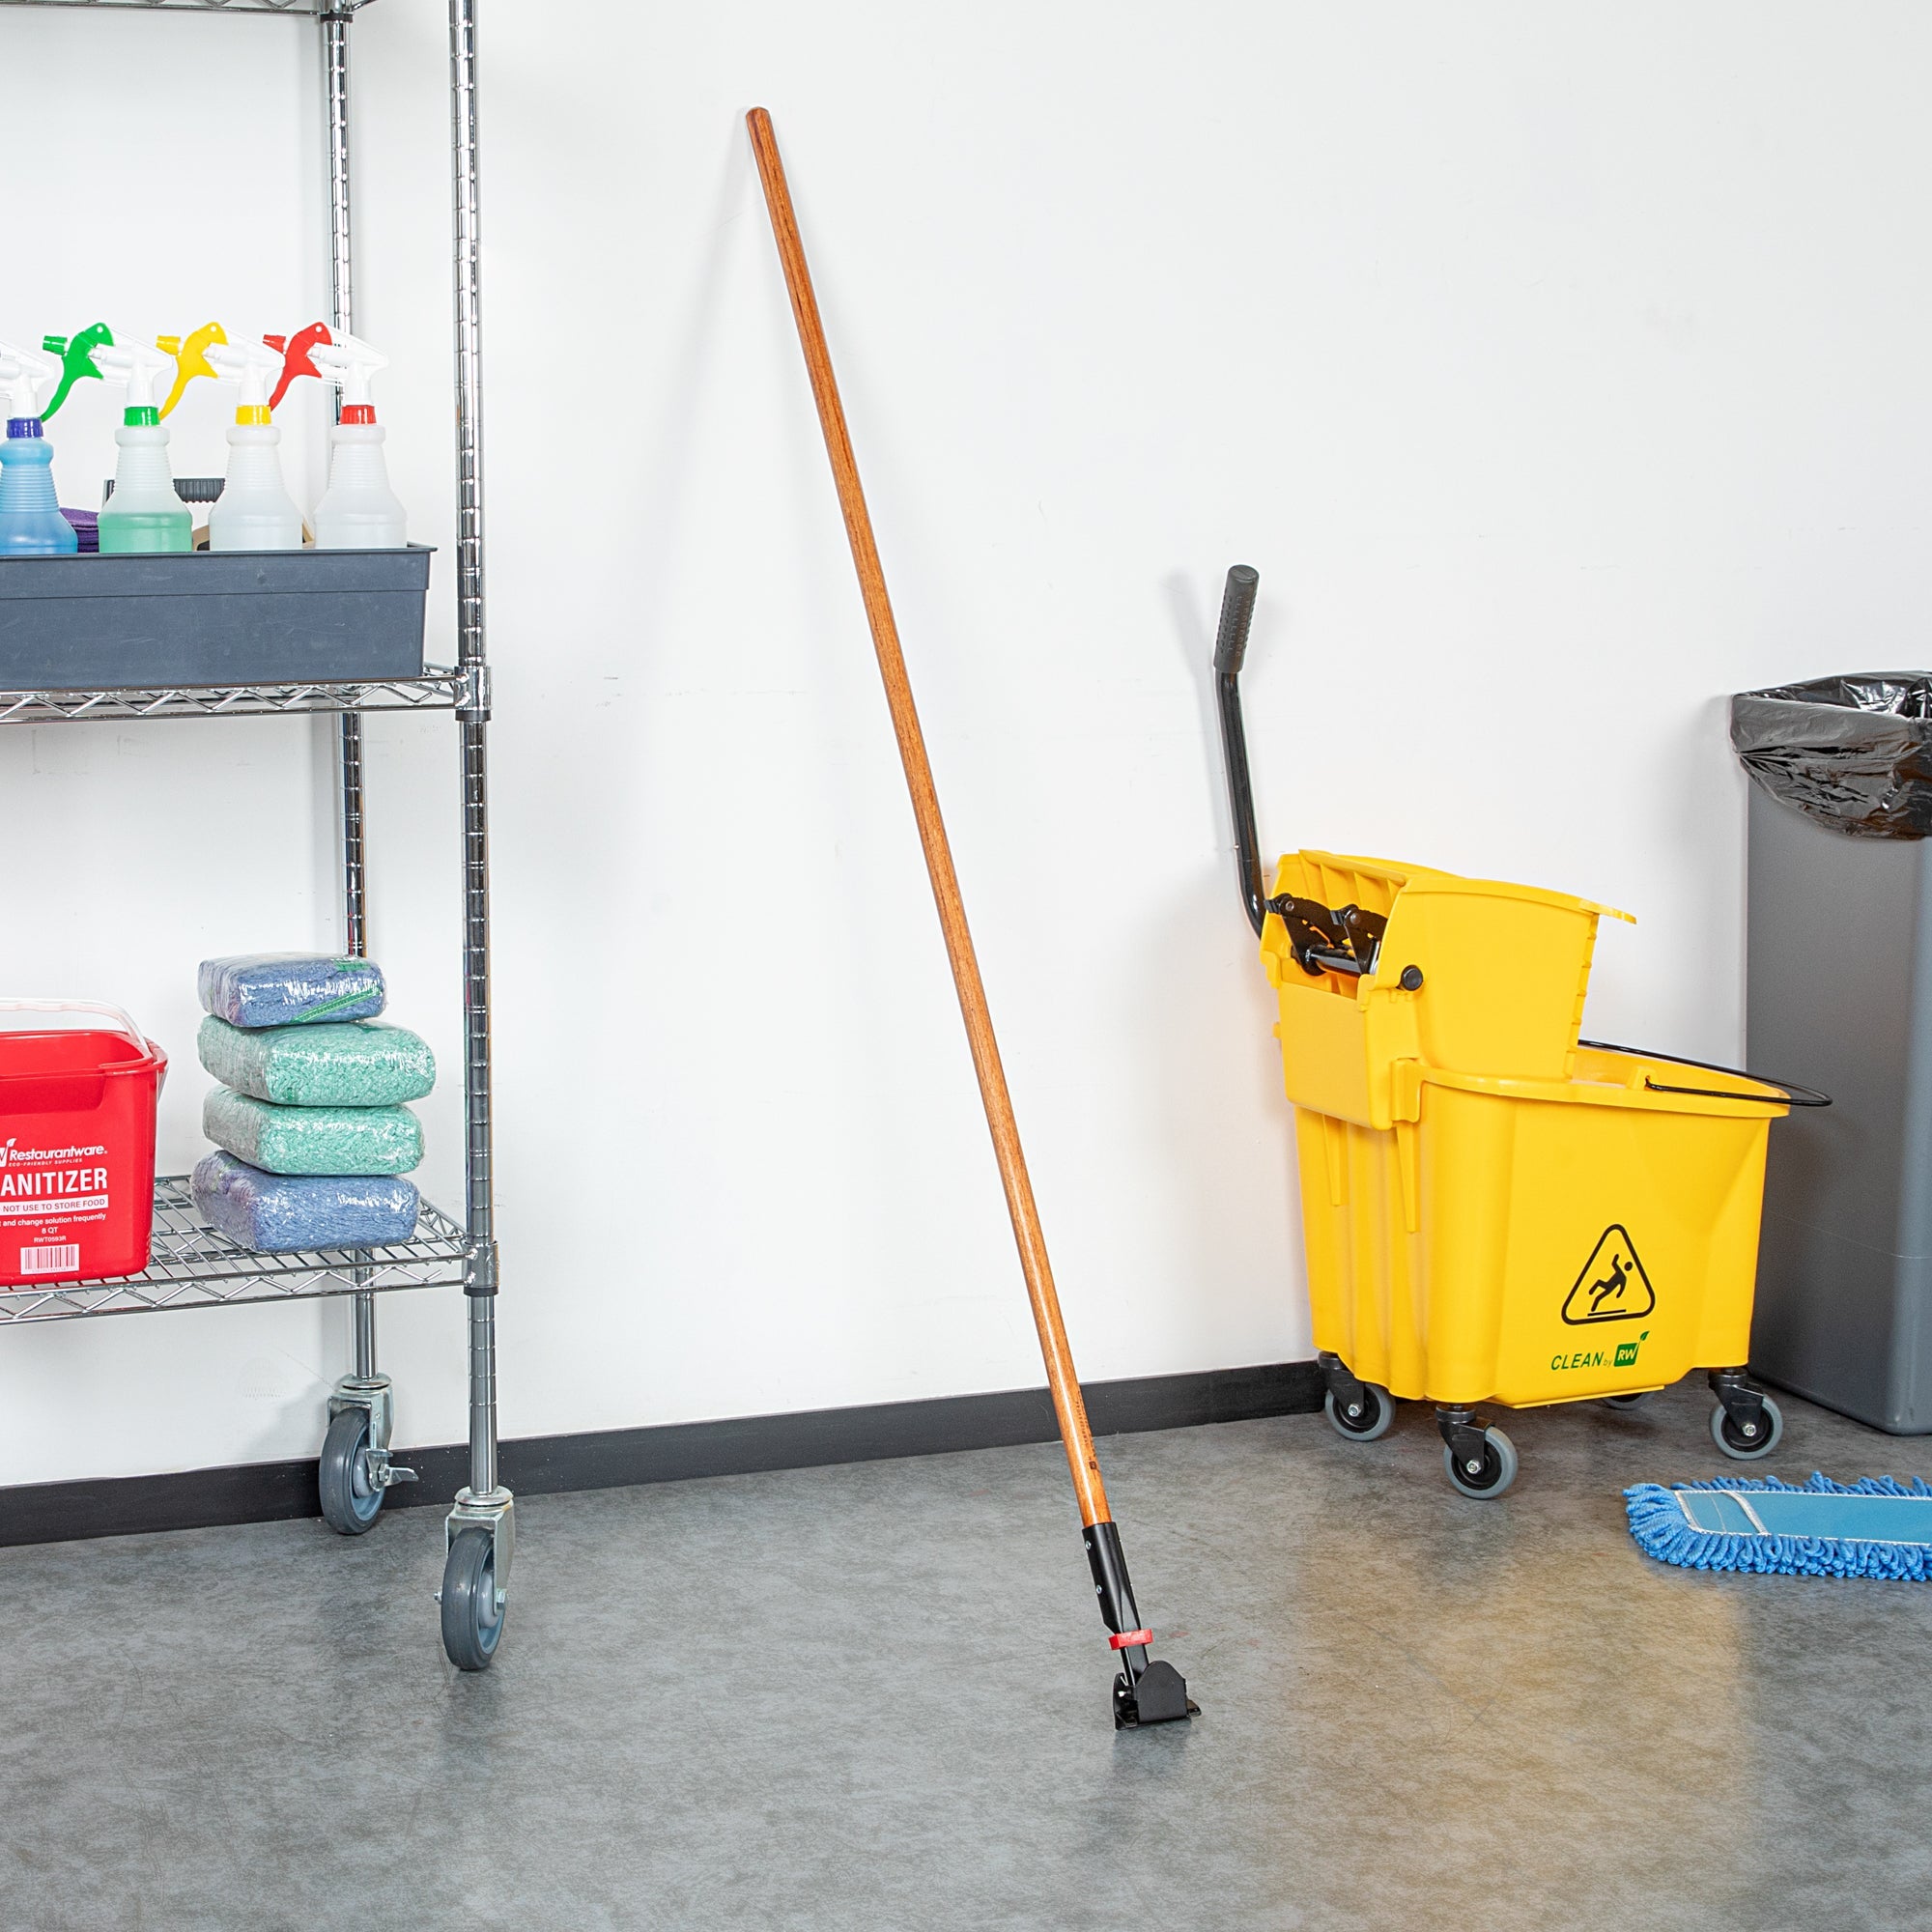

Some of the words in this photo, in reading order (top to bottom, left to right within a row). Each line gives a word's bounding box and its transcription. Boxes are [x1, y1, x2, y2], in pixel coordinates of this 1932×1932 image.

[1, 1168, 107, 1196] ANITIZER
[54, 1201, 80, 1209] STORE
[83, 1198, 105, 1207] FOOD
[3, 1218, 16, 1227] and
[17, 1218, 43, 1227] change
[44, 1215, 71, 1225] solution
[73, 1212, 106, 1222] frequently
[1551, 1351, 1604, 1370] CLEAN
[1604, 1359, 1612, 1368] by
